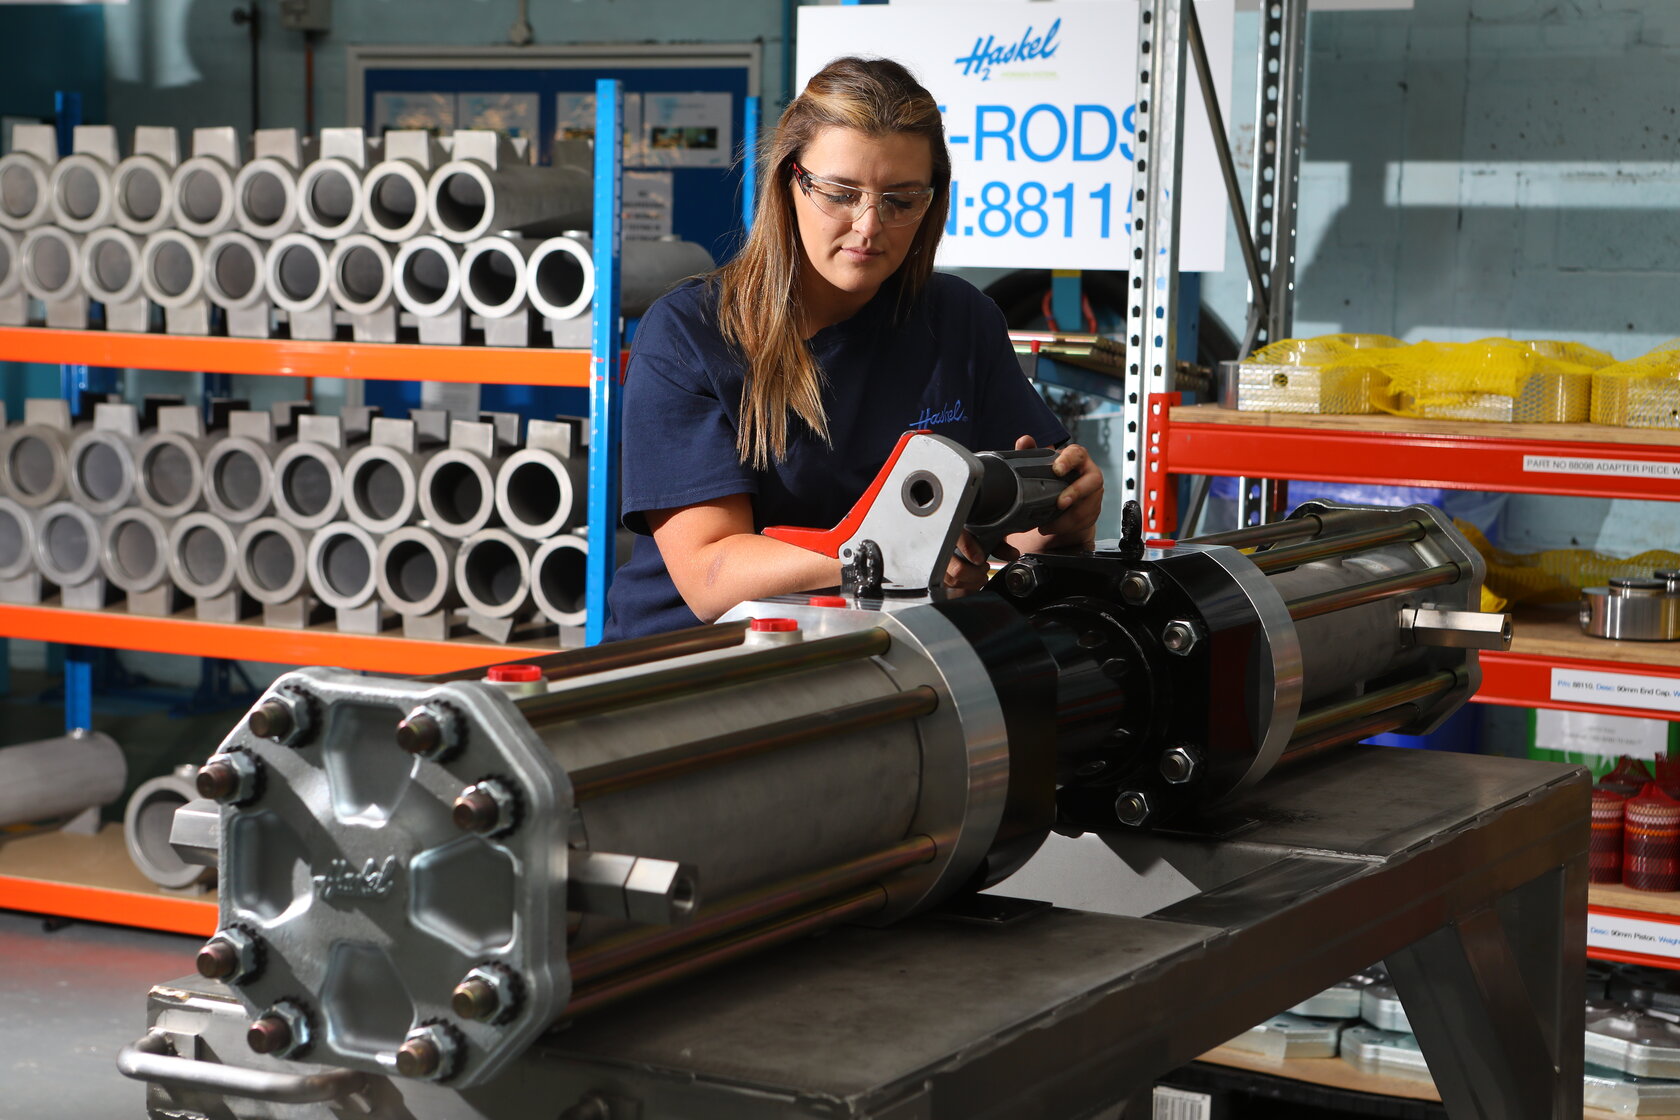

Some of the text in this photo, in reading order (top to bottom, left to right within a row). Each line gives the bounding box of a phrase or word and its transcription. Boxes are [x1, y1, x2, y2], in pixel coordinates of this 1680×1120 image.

[938, 104, 1137, 163] -ROD
[944, 181, 1134, 240] :8811
[909, 399, 965, 430] Haskel
[1526, 459, 1551, 468] PART
[1553, 460, 1567, 469] NO
[1596, 462, 1640, 473] ADAPTER
[1642, 464, 1669, 475] PIECE
[1640, 686, 1654, 696] End
